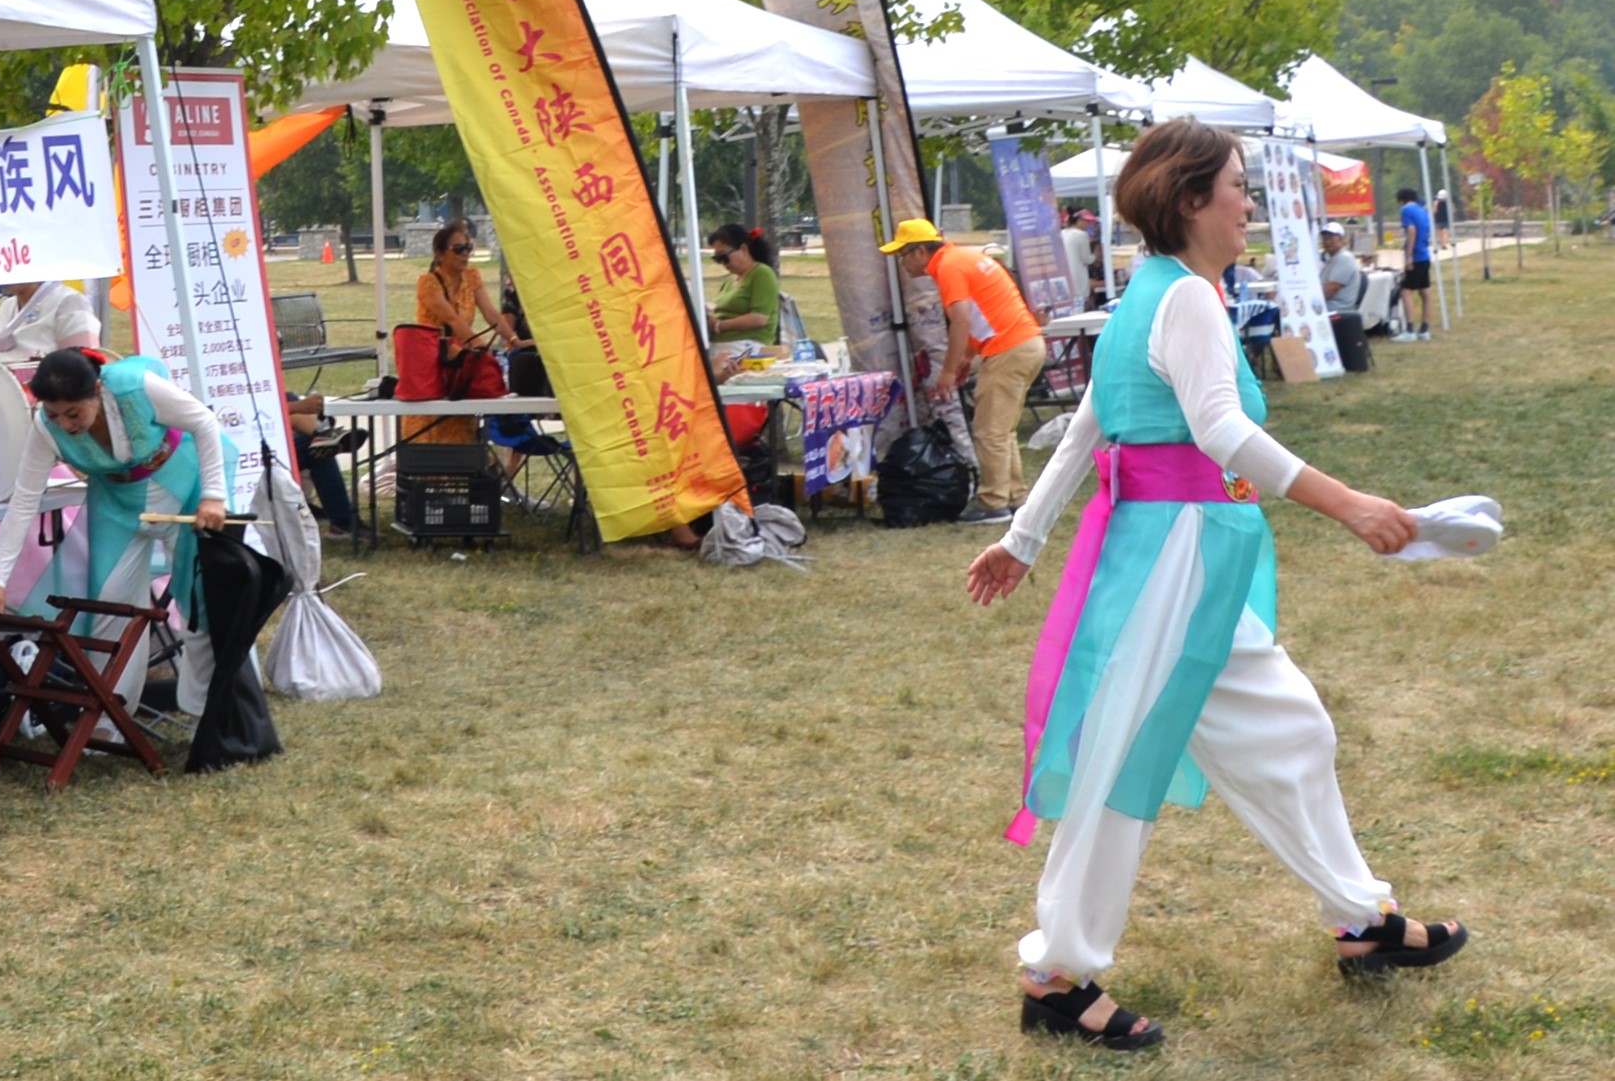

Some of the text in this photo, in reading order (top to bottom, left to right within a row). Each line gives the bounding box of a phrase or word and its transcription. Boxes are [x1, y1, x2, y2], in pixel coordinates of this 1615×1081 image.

[499, 88, 532, 146] Canada
[533, 165, 581, 261] Association
[577, 273, 593, 295] du
[586, 299, 620, 365] Shaanxi
[611, 370, 628, 392] du
[621, 396, 650, 459] Canada
